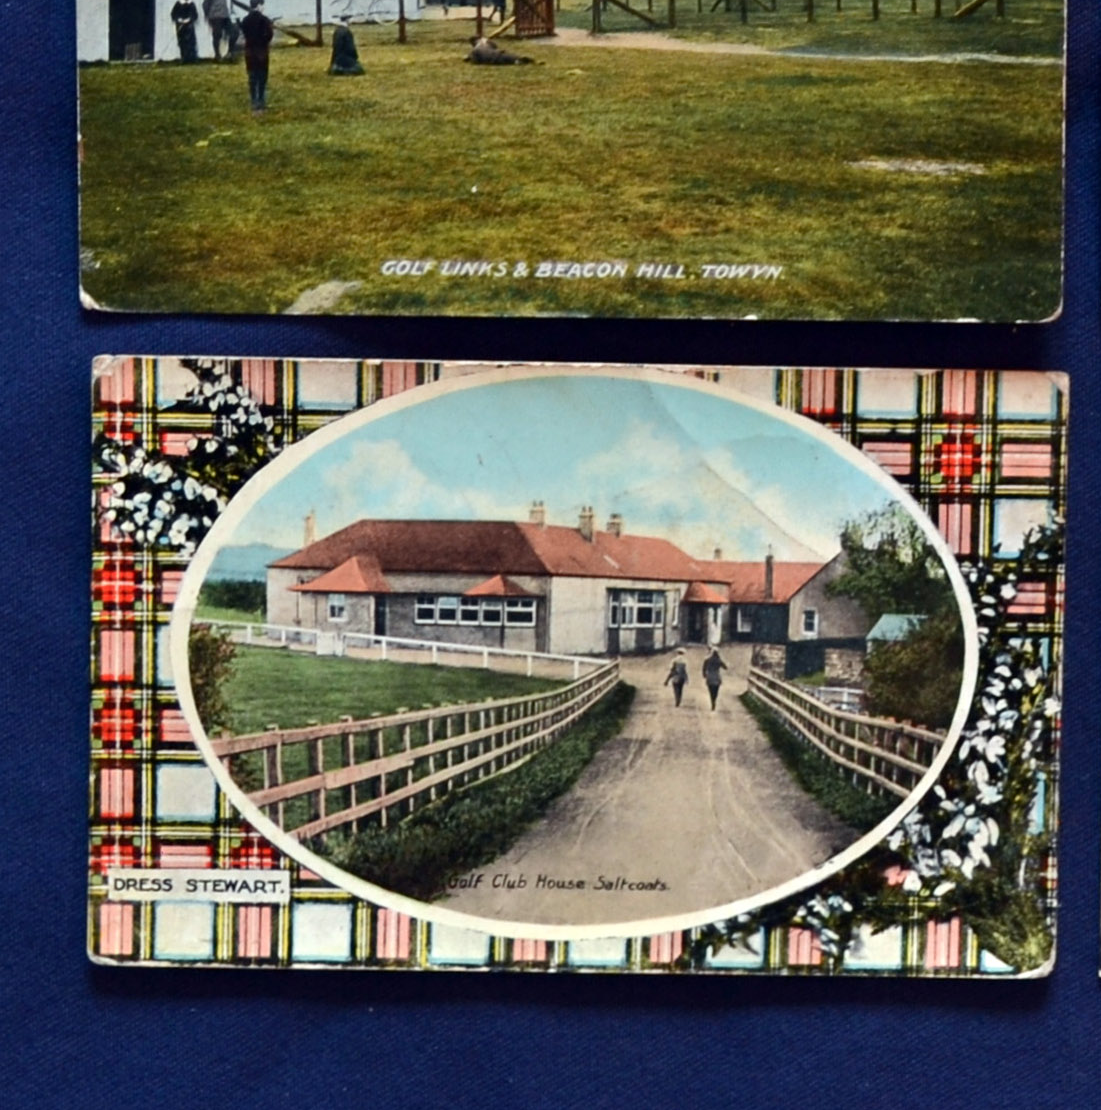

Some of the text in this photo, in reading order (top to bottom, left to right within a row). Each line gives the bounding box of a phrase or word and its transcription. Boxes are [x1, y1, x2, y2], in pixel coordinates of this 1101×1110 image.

[381, 260, 436, 276] GOLF
[440, 260, 507, 277] LINKS
[513, 261, 529, 277] &
[534, 261, 628, 278] BEACON
[113, 877, 285, 894] DRESS STEWART.
[449, 873, 484, 889] Golf
[491, 874, 527, 889] Club
[536, 874, 586, 890] House
